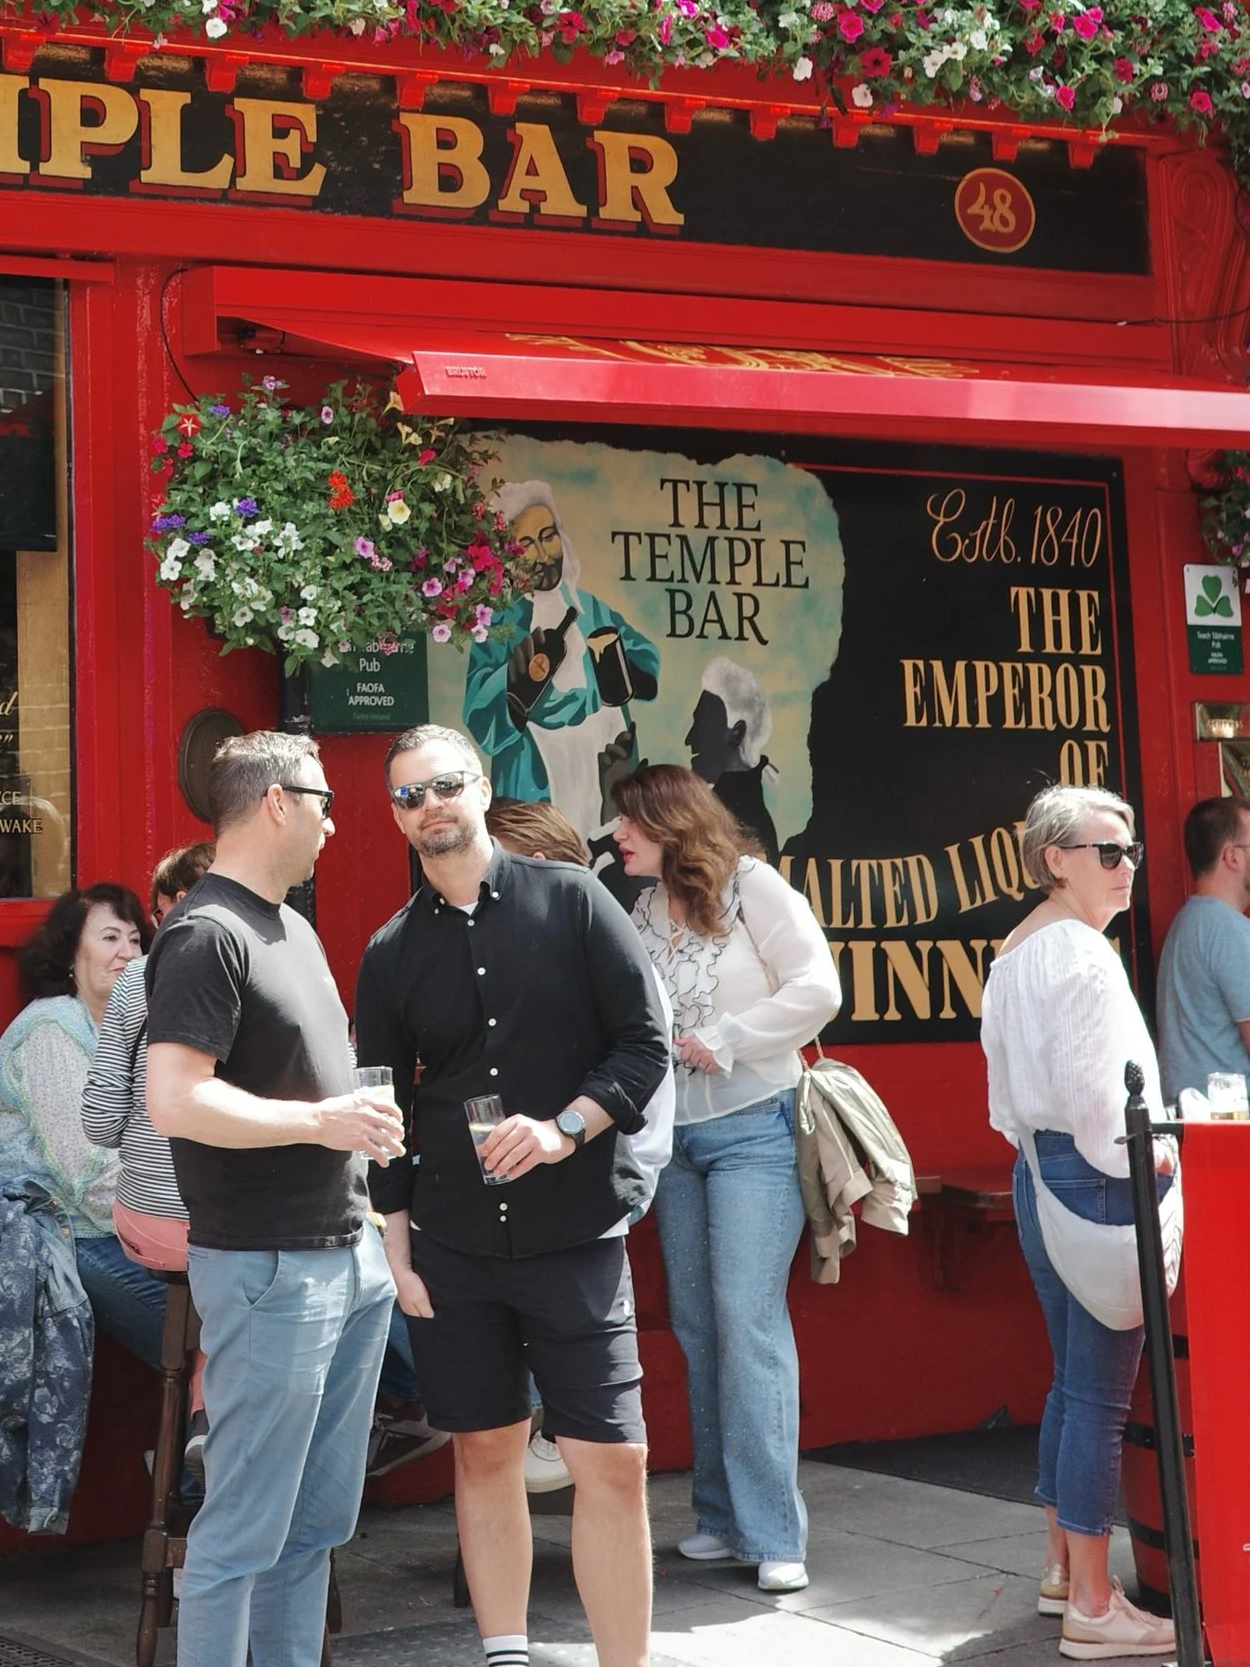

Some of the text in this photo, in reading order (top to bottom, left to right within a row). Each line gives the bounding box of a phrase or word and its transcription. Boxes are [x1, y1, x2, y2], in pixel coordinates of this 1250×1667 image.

[396, 111, 685, 231] BAR
[967, 181, 1016, 233] 48
[659, 477, 762, 533] THE
[610, 530, 810, 590] TEMPLE
[1031, 504, 1102, 568] 1840
[664, 587, 770, 646] BAR
[1010, 586, 1102, 656] THE
[358, 657, 381, 672] Pub
[347, 695, 395, 707] APPROVED
[900, 659, 1111, 734] EMPEROR
[1059, 739, 1109, 788] OF
[0, 818, 43, 834] WAKE
